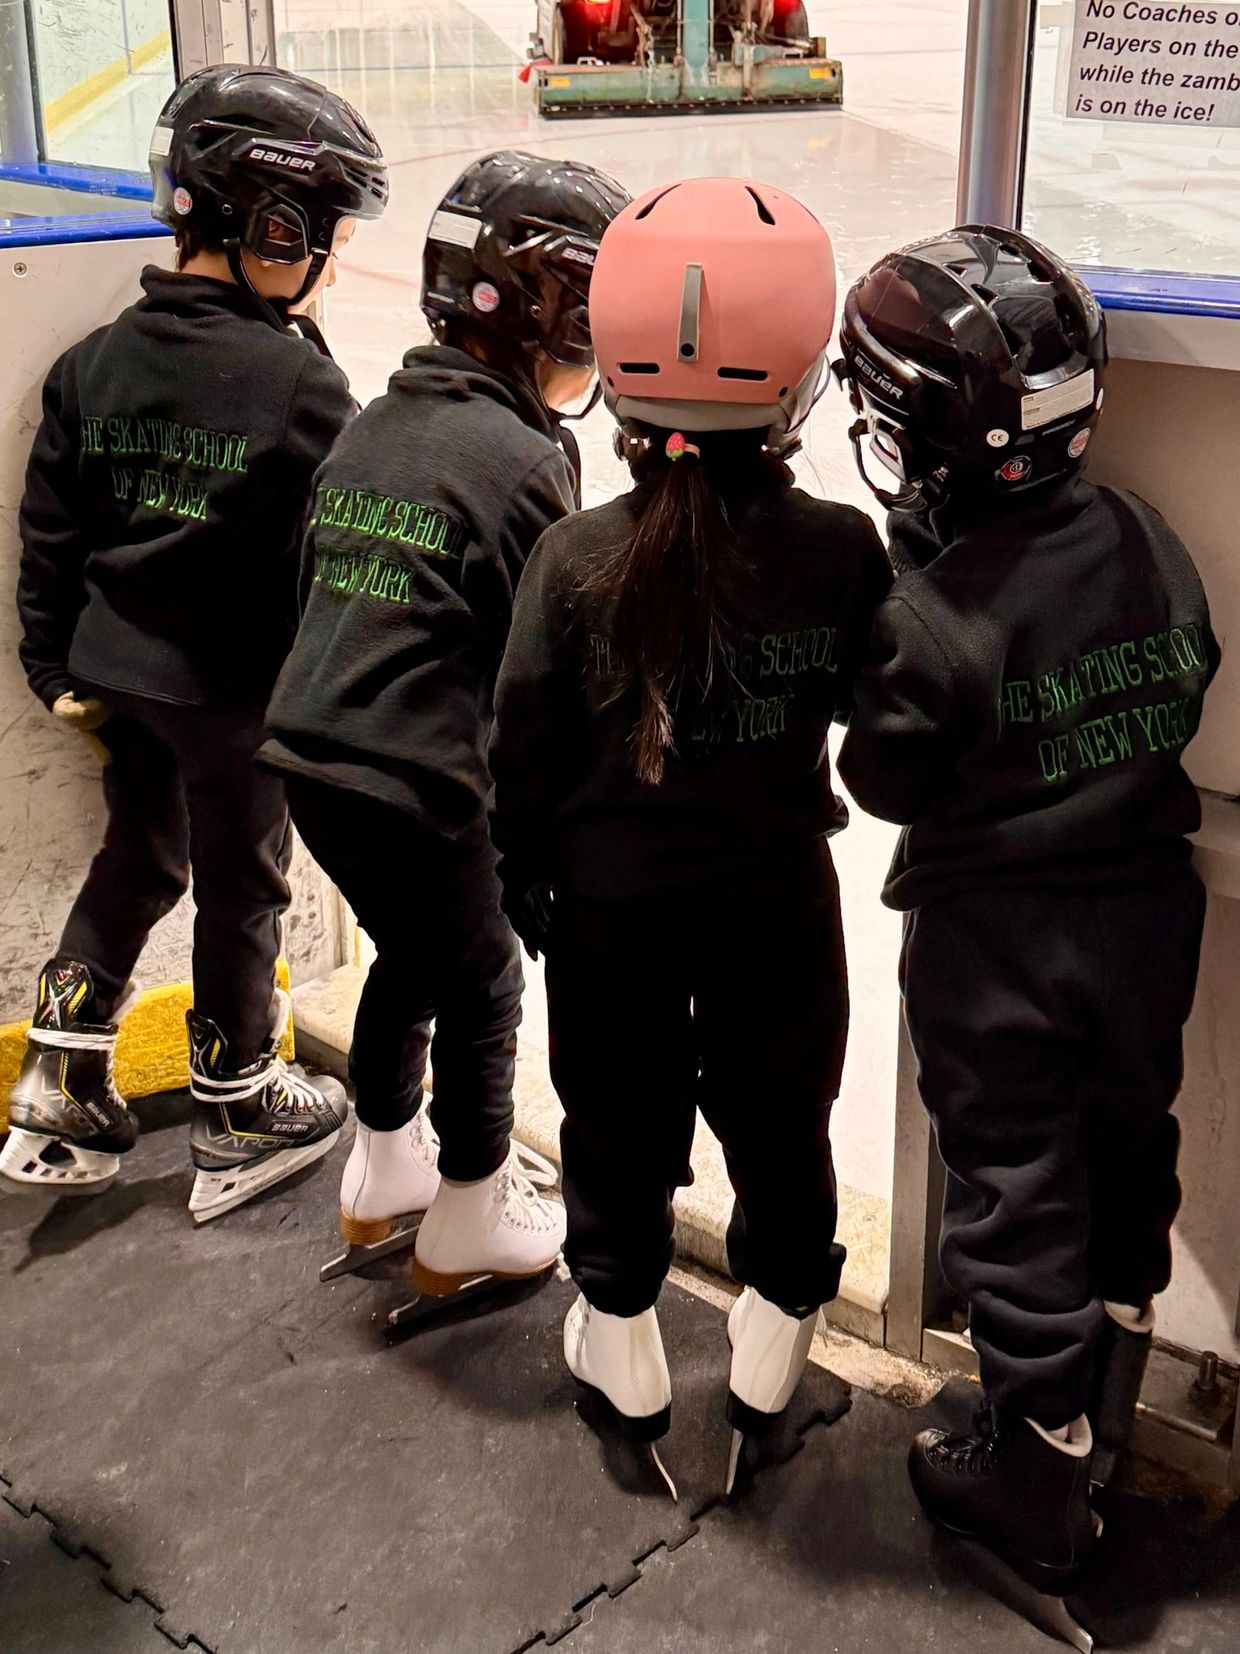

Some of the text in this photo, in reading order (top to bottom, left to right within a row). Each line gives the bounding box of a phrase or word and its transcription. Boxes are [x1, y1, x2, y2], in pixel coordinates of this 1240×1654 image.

[1086, 0, 1240, 26] No Coaches o
[1082, 31, 1239, 58] Players on the
[1080, 64, 1134, 84] while
[1141, 67, 1174, 86] the
[1075, 94, 1215, 122] is on the ice!
[81, 416, 248, 473] HE SKATING SCHOOL
[760, 626, 838, 677] SCHOOL
[999, 681, 1034, 726] HE
[1037, 641, 1143, 722] SKATING
[1038, 735, 1070, 782] OF
[1075, 712, 1132, 769] NEW
